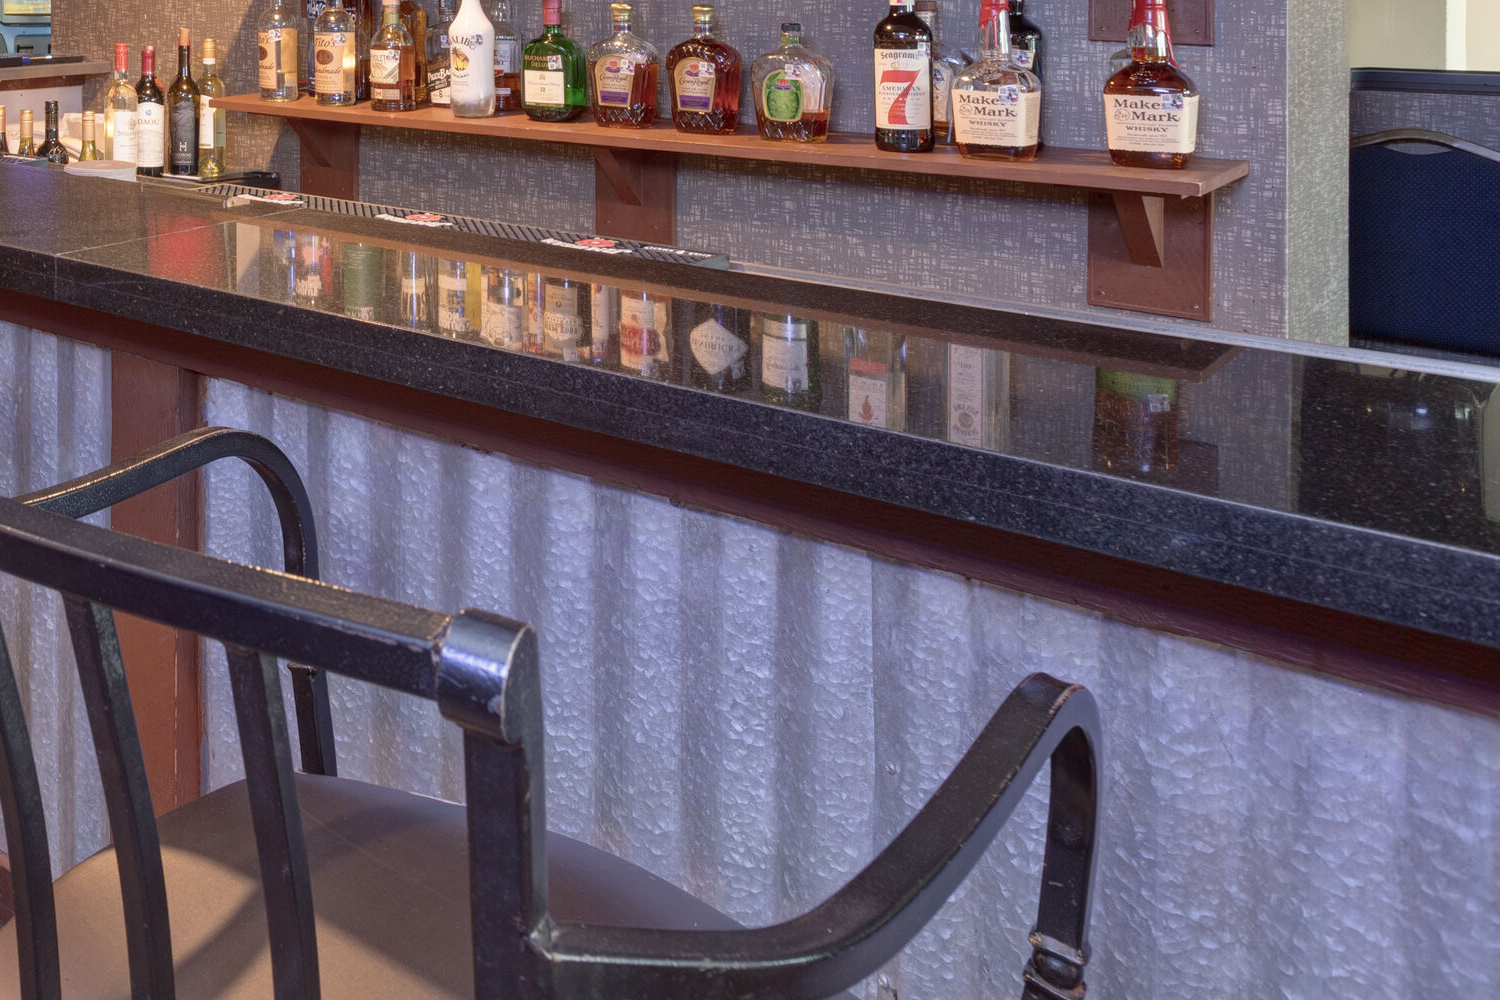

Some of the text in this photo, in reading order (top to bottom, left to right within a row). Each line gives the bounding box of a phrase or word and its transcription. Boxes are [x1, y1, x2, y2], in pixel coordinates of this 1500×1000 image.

[879, 68, 922, 126] 7
[974, 106, 1017, 117] Mark
[1132, 111, 1180, 122] Mark
